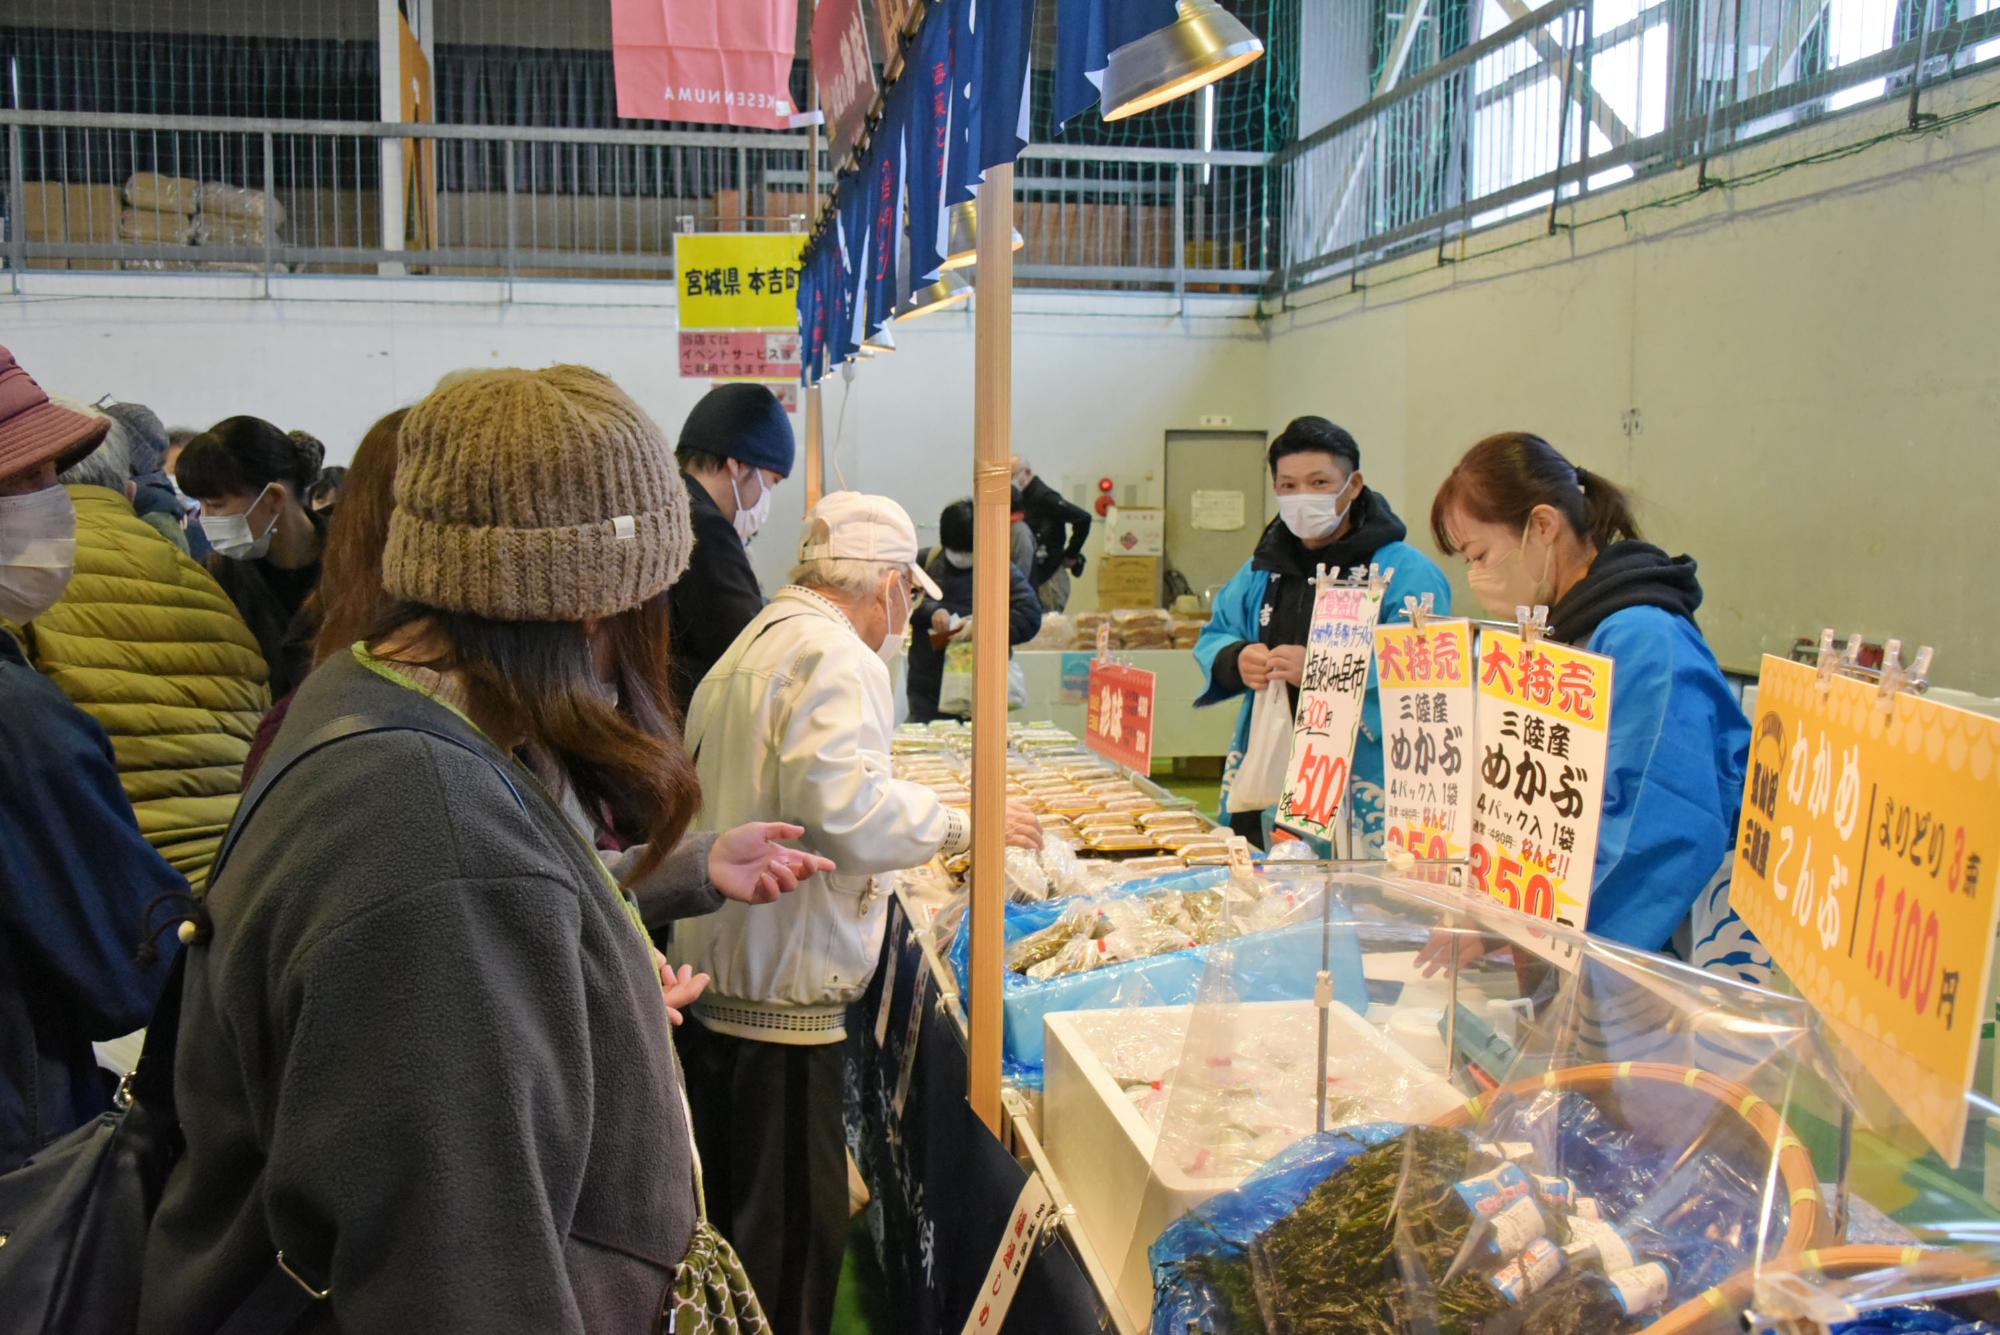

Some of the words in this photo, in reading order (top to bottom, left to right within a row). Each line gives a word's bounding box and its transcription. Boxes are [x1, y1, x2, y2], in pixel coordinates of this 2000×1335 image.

[685, 267, 741, 296] 宮城県
[1379, 632, 1461, 681] 大特売
[1481, 640, 1596, 721] 大特売
[1400, 692, 1449, 723] 三陸産
[1391, 725, 1463, 776] めかぶ
[1500, 711, 1571, 760] 三陸産
[1390, 778, 1437, 803] 4パック入
[1482, 742, 1589, 819] めかぶ
[1788, 719, 1860, 842] わかめ
[1476, 793, 1543, 840] 4パック入
[1552, 822, 1575, 853] 1袋
[1521, 837, 1570, 881] なんと!!
[1774, 825, 1848, 951] こんぶ
